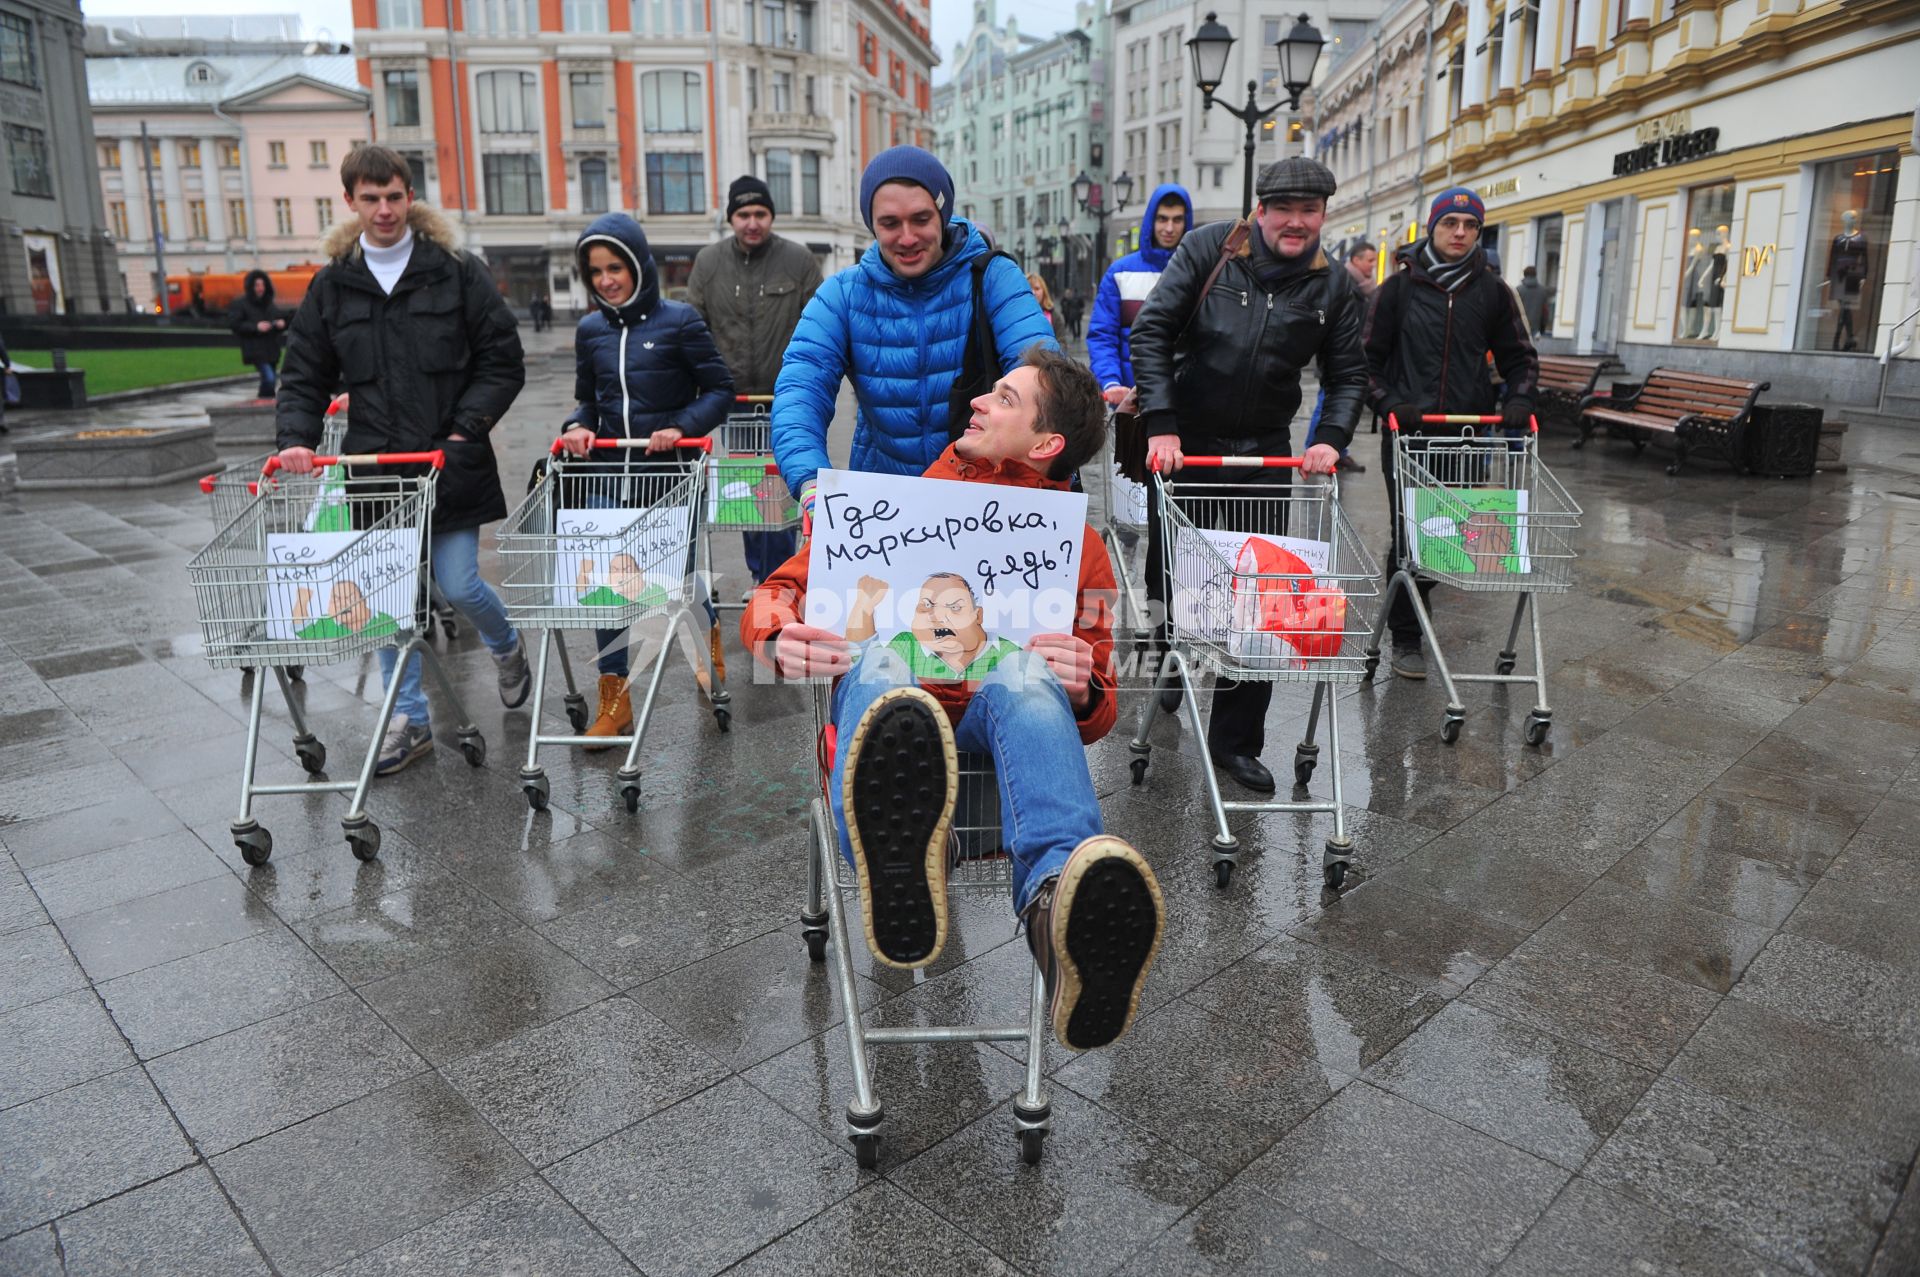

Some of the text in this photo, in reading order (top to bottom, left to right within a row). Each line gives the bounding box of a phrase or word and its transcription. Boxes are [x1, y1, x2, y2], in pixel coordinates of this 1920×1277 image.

[824, 493, 900, 539] Где
[826, 500, 1058, 570] маркировка,
[977, 540, 1073, 596] дядь?
